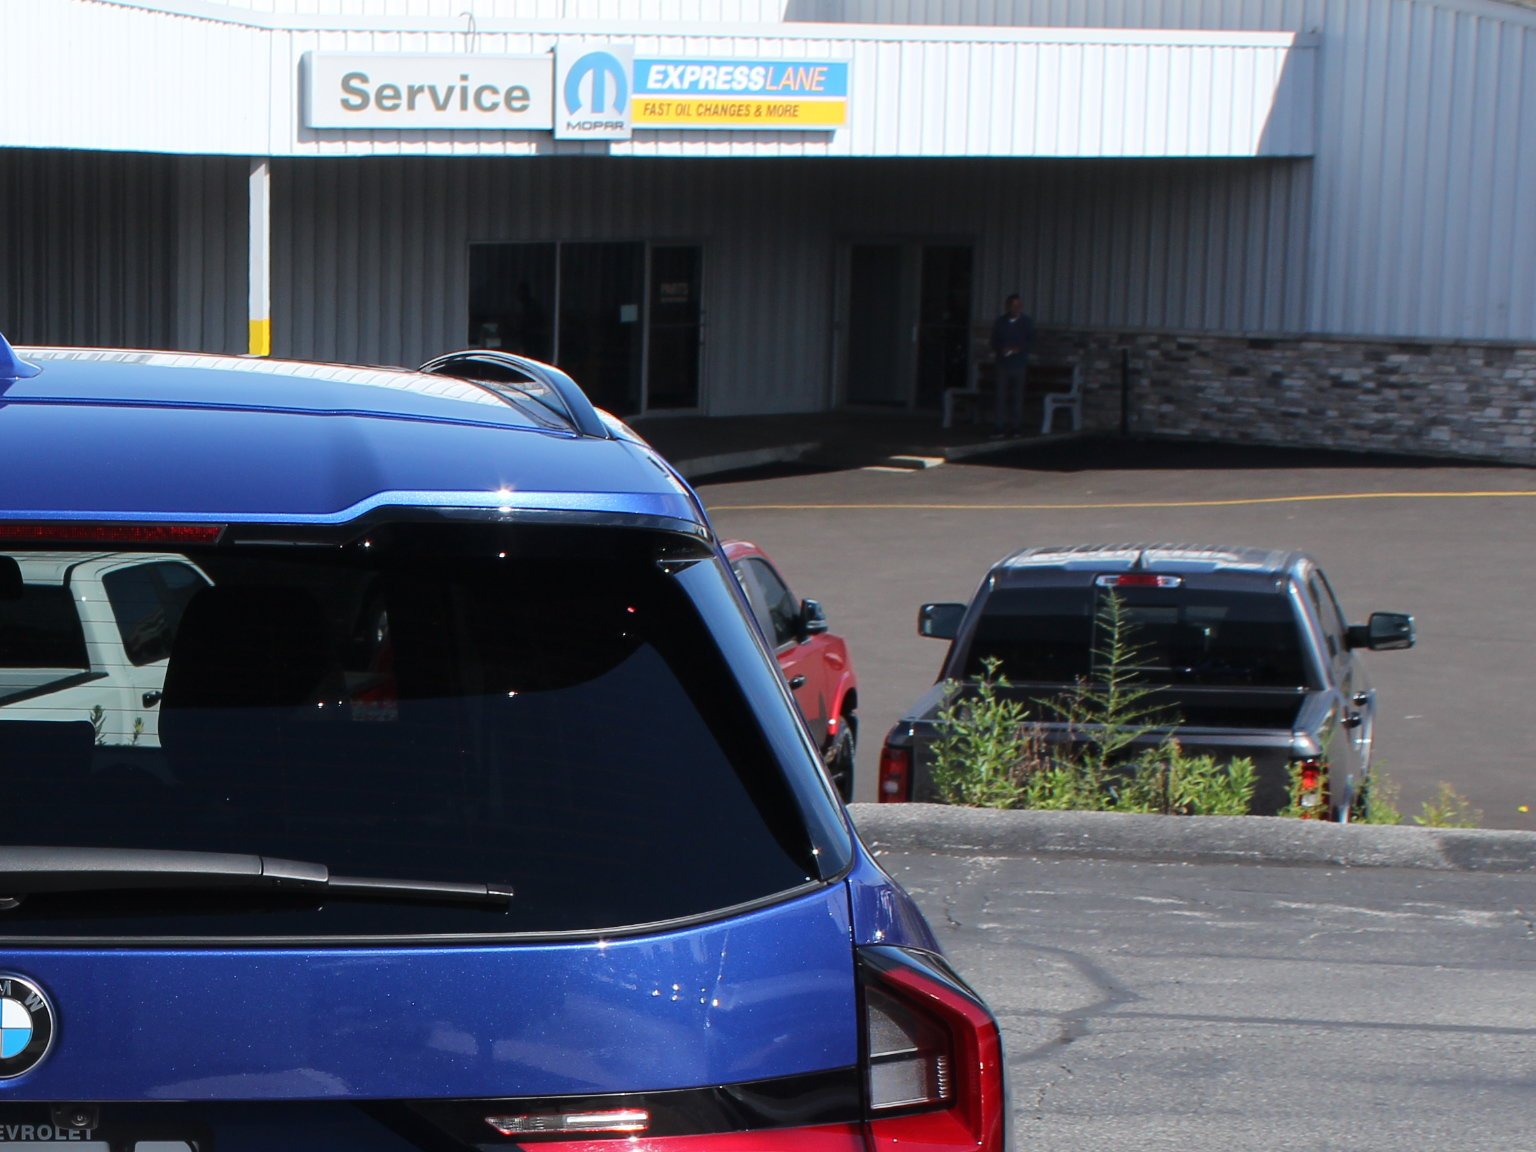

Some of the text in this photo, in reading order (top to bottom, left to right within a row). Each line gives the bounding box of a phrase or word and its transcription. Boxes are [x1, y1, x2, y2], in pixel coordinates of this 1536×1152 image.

[339, 72, 531, 113] Service
[643, 103, 800, 118] FAST OIL CHANGES & MORE
[566, 121, 624, 131] MOPAR
